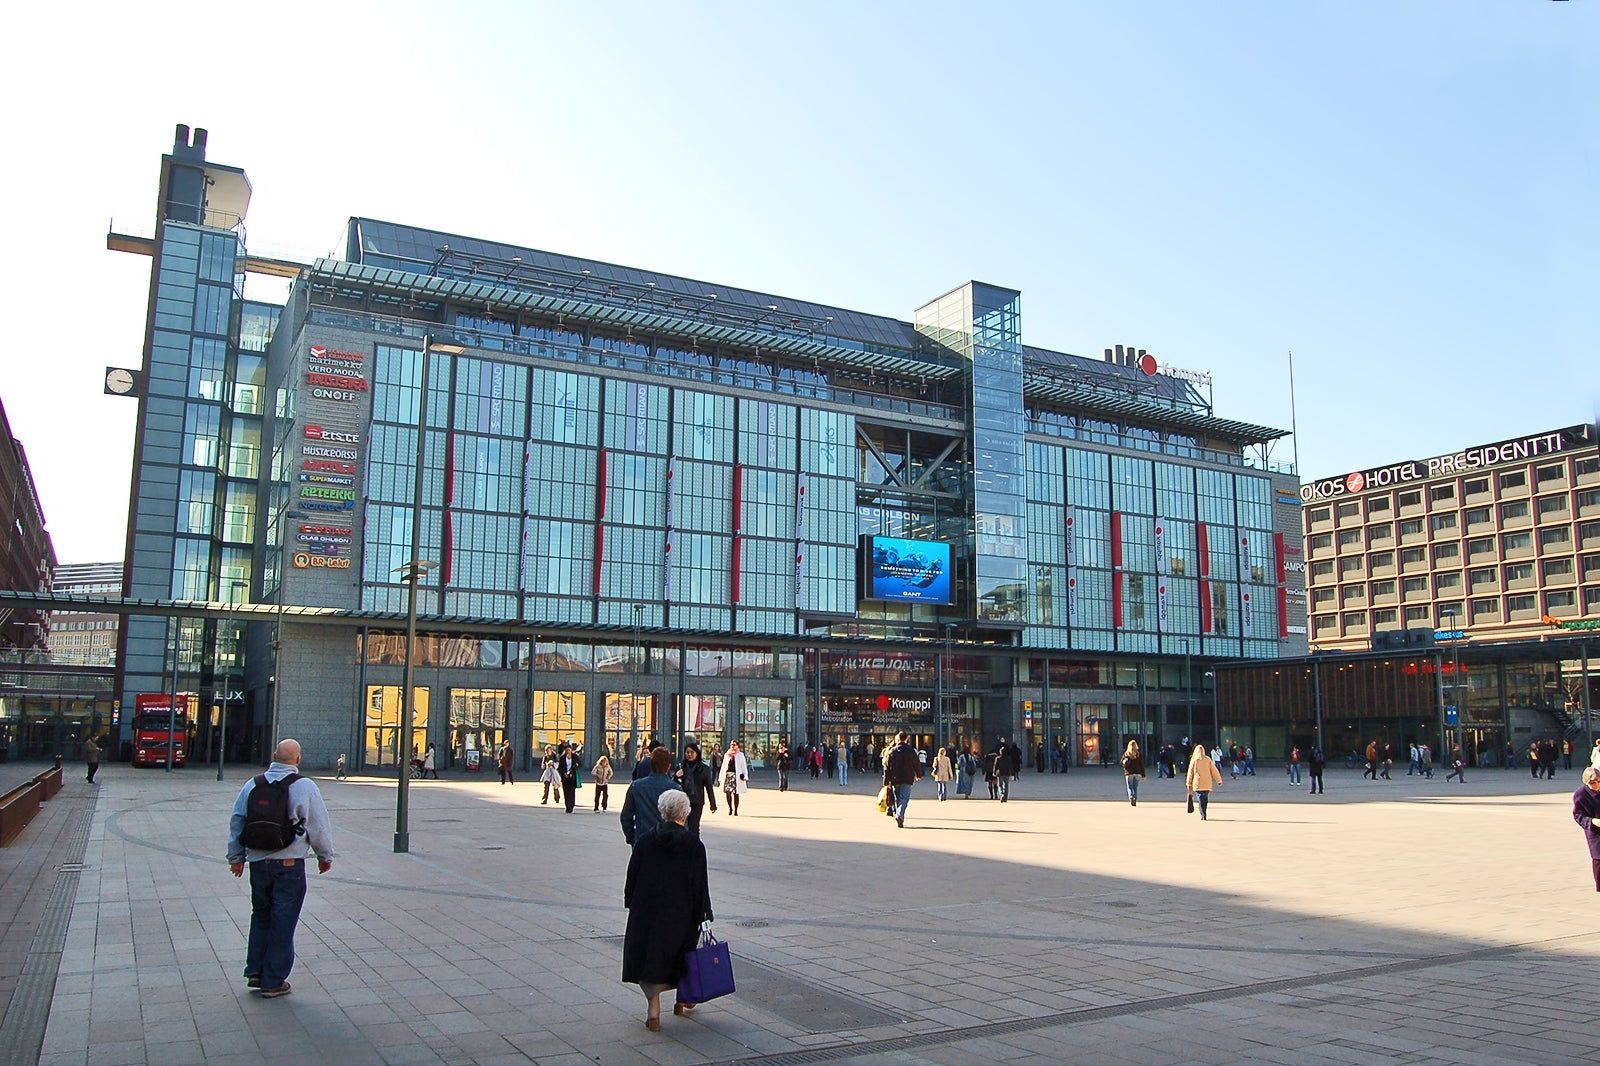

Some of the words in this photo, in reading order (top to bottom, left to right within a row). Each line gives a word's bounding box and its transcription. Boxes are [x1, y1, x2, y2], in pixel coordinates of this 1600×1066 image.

[308, 365, 332, 373] VERO
[334, 369, 360, 378] MODA
[313, 388, 355, 400] ONOFF
[1365, 462, 1422, 489] HOTEL
[1428, 433, 1562, 476] PRESIDENTTI
[301, 486, 355, 500] APTEEKKI
[892, 697, 931, 712] Kamppi
